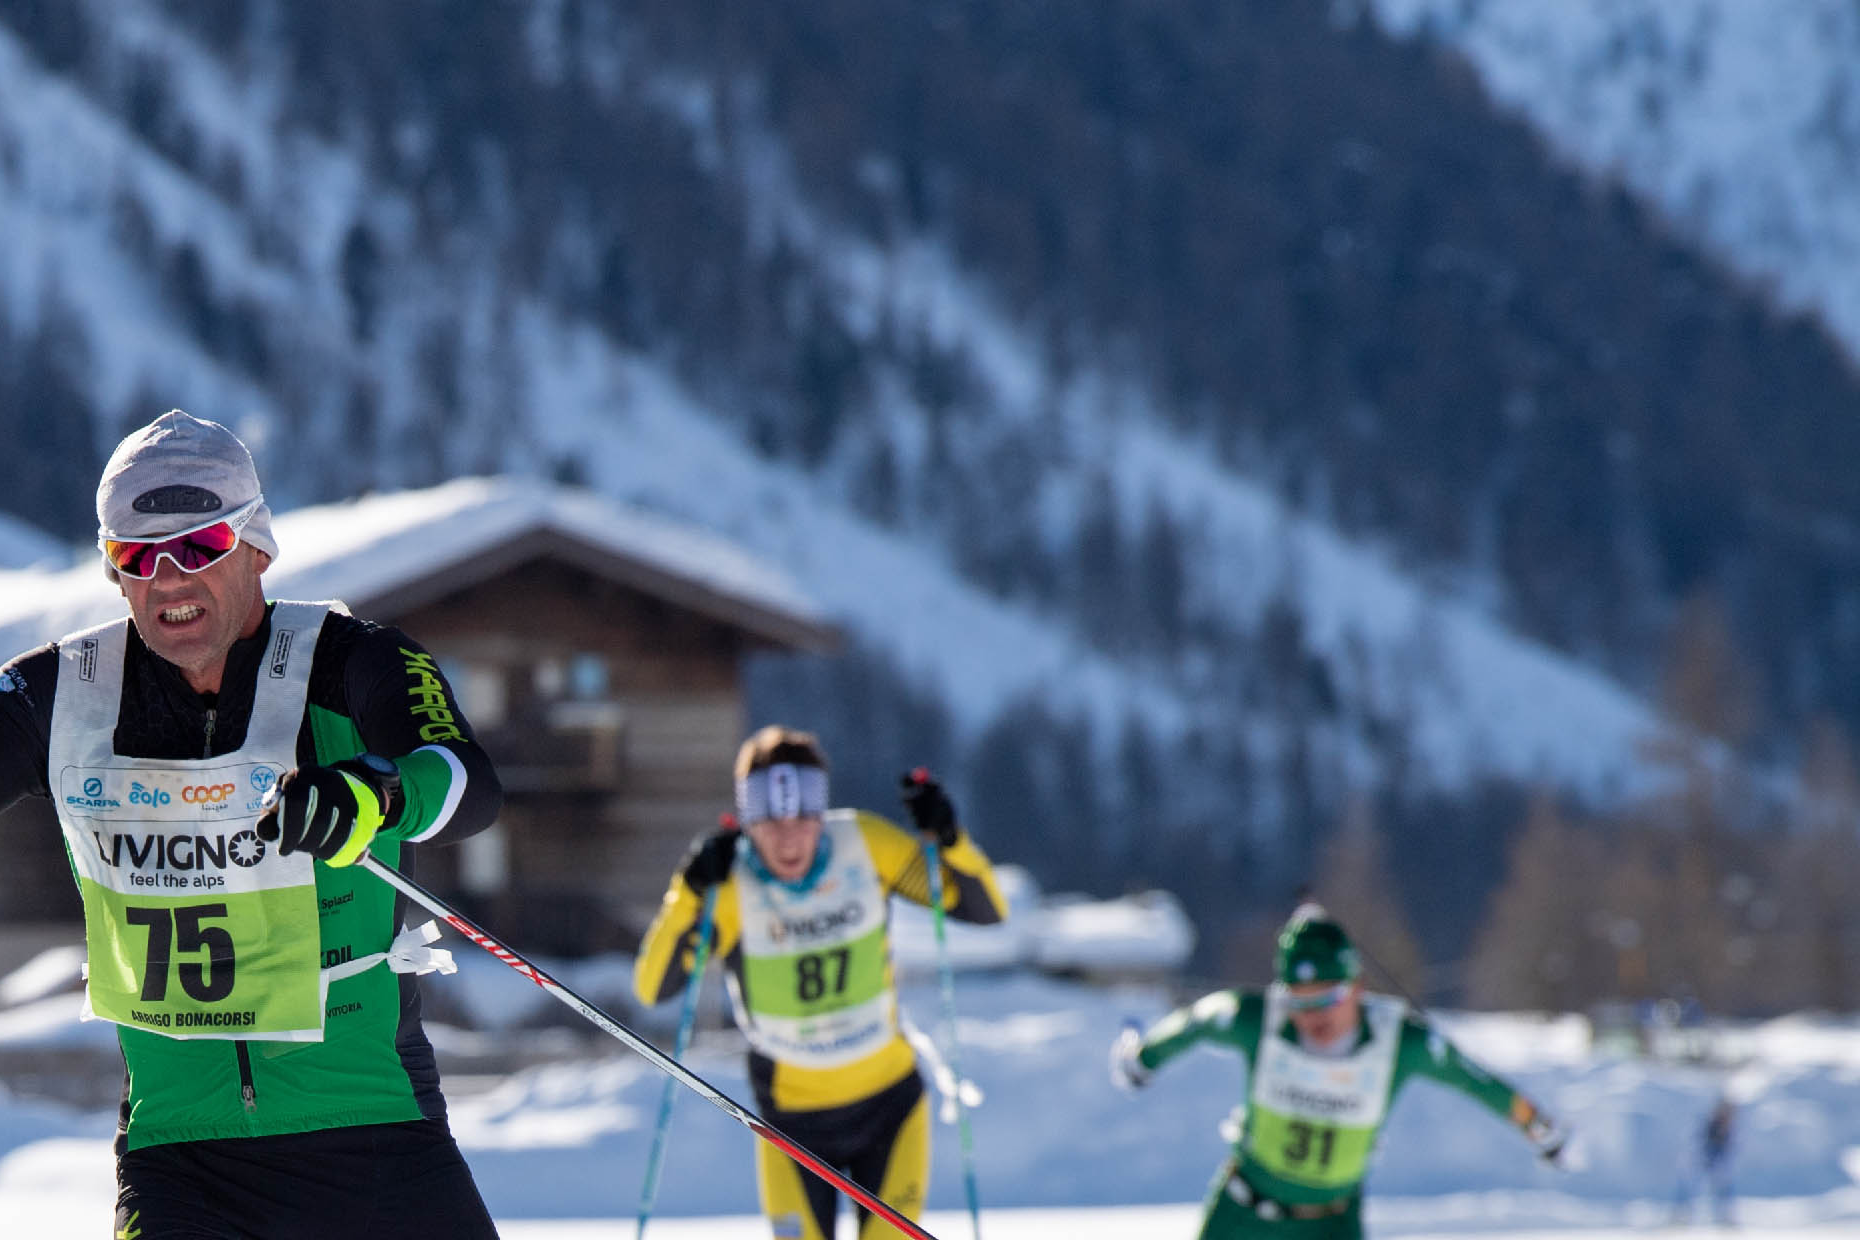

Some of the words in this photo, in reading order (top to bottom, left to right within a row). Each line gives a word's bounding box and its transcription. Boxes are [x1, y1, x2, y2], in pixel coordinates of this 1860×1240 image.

[66, 796, 121, 808] SCARPA
[129, 787, 171, 808] eolo
[93, 830, 266, 871] LIVIGNO
[130, 872, 160, 887] feel
[163, 872, 189, 887] the
[193, 874, 225, 889] alps
[125, 903, 236, 1003] 75
[796, 947, 852, 1004] 87
[131, 1010, 171, 1028] ARRIGO
[175, 1010, 256, 1027] BONACORSI
[1284, 1120, 1336, 1168] 31
